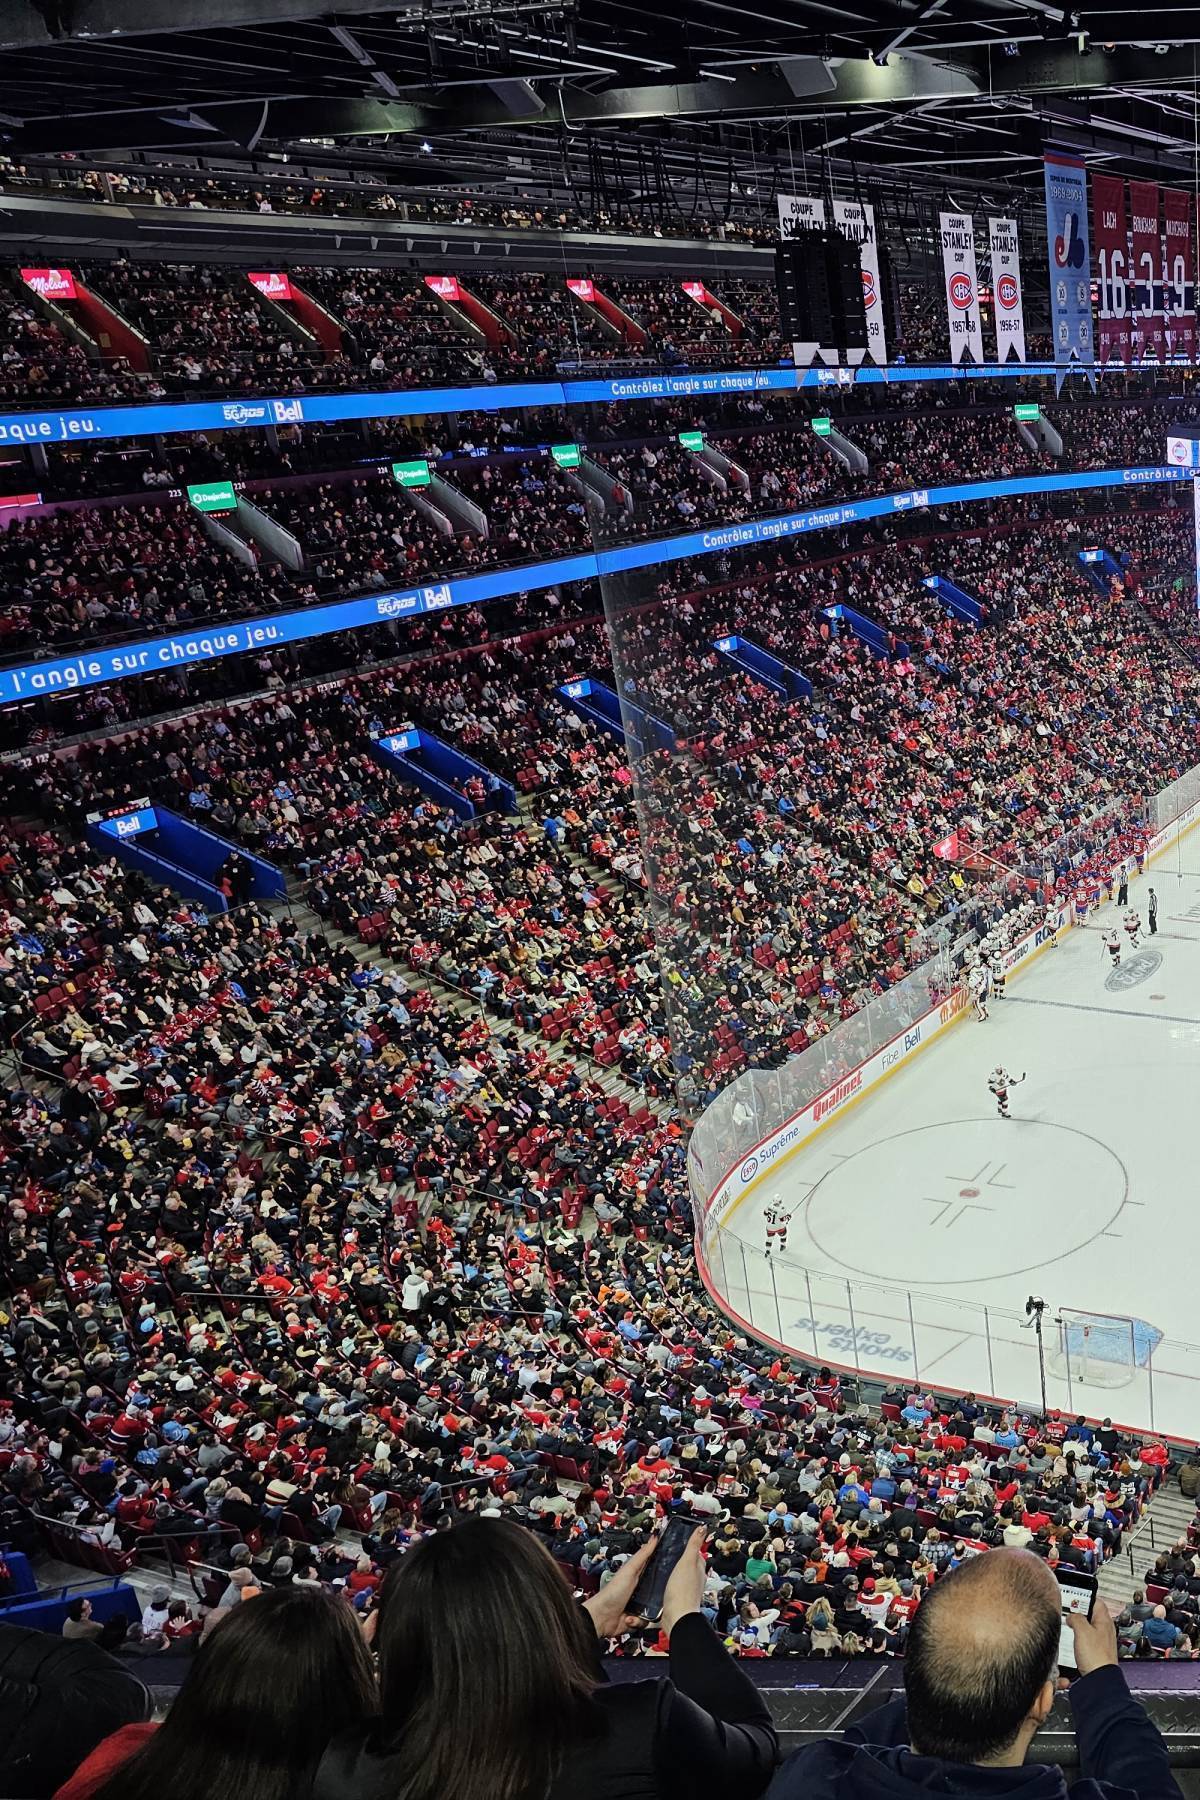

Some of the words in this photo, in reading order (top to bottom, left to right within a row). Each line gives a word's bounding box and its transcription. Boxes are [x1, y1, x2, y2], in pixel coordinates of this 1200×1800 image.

[790, 202, 814, 216] COUPE
[948, 218, 966, 230] COUPE
[996, 223, 1011, 234] COUPE
[1102, 211, 1117, 230] LACH
[942, 231, 974, 251] STANLEY
[991, 235, 1018, 253] STANLEY
[954, 253, 965, 263] CUP
[1001, 254, 1010, 265] CUP
[1098, 248, 1128, 320] 16
[1140, 252, 1154, 319] 3
[1172, 255, 1186, 318] 9
[999, 319, 1021, 332] 1956-57
[610, 379, 664, 396] Contrôlez
[665, 379, 701, 394] l'angle
[703, 379, 718, 391] sur
[720, 375, 754, 391] chaque
[755, 375, 773, 389] jeu.
[273, 400, 304, 422] Bell
[60, 416, 102, 439] jeu.
[1122, 469, 1178, 482] Contrôlez
[202, 491, 232, 502] Desjardins
[912, 490, 929, 507] Bell
[703, 529, 754, 549] Contrôlez
[755, 519, 789, 538] l'angle
[791, 518, 806, 531] sur
[807, 510, 841, 529] chaque
[840, 506, 858, 523] jeu.
[425, 586, 453, 610] Bell
[11, 660, 102, 693] l'angle
[110, 650, 150, 672] sur
[158, 633, 239, 662] chaque
[245, 625, 285, 649] jeu.
[391, 736, 409, 751] Bell
[116, 816, 140, 832] Bell
[881, 1050, 899, 1071] Fibe
[904, 1029, 922, 1052] Bell
[812, 1070, 864, 1122] Qualinet
[759, 1126, 800, 1164] Suprême
[792, 1316, 892, 1346] experts
[826, 1334, 913, 1363] sports
